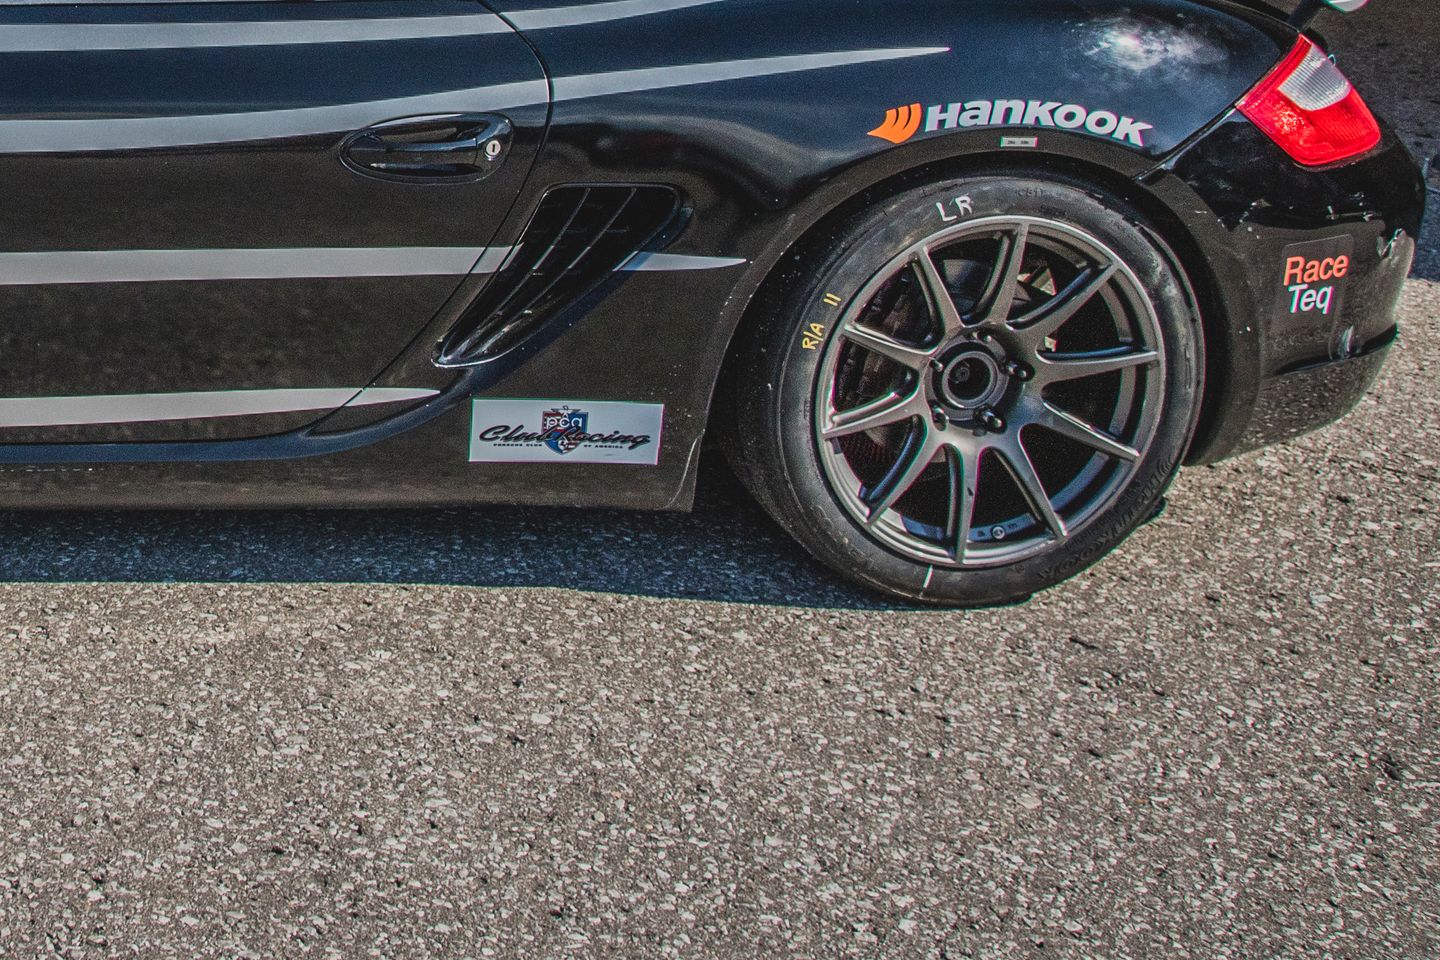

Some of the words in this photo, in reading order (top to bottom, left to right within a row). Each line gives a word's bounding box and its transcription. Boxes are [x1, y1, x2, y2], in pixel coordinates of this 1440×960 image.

[935, 195, 974, 222] LR
[1283, 255, 1349, 286] Race
[1288, 283, 1334, 315] Teq
[546, 417, 582, 429] pca
[479, 424, 560, 443] Club
[557, 425, 651, 450] Racing
